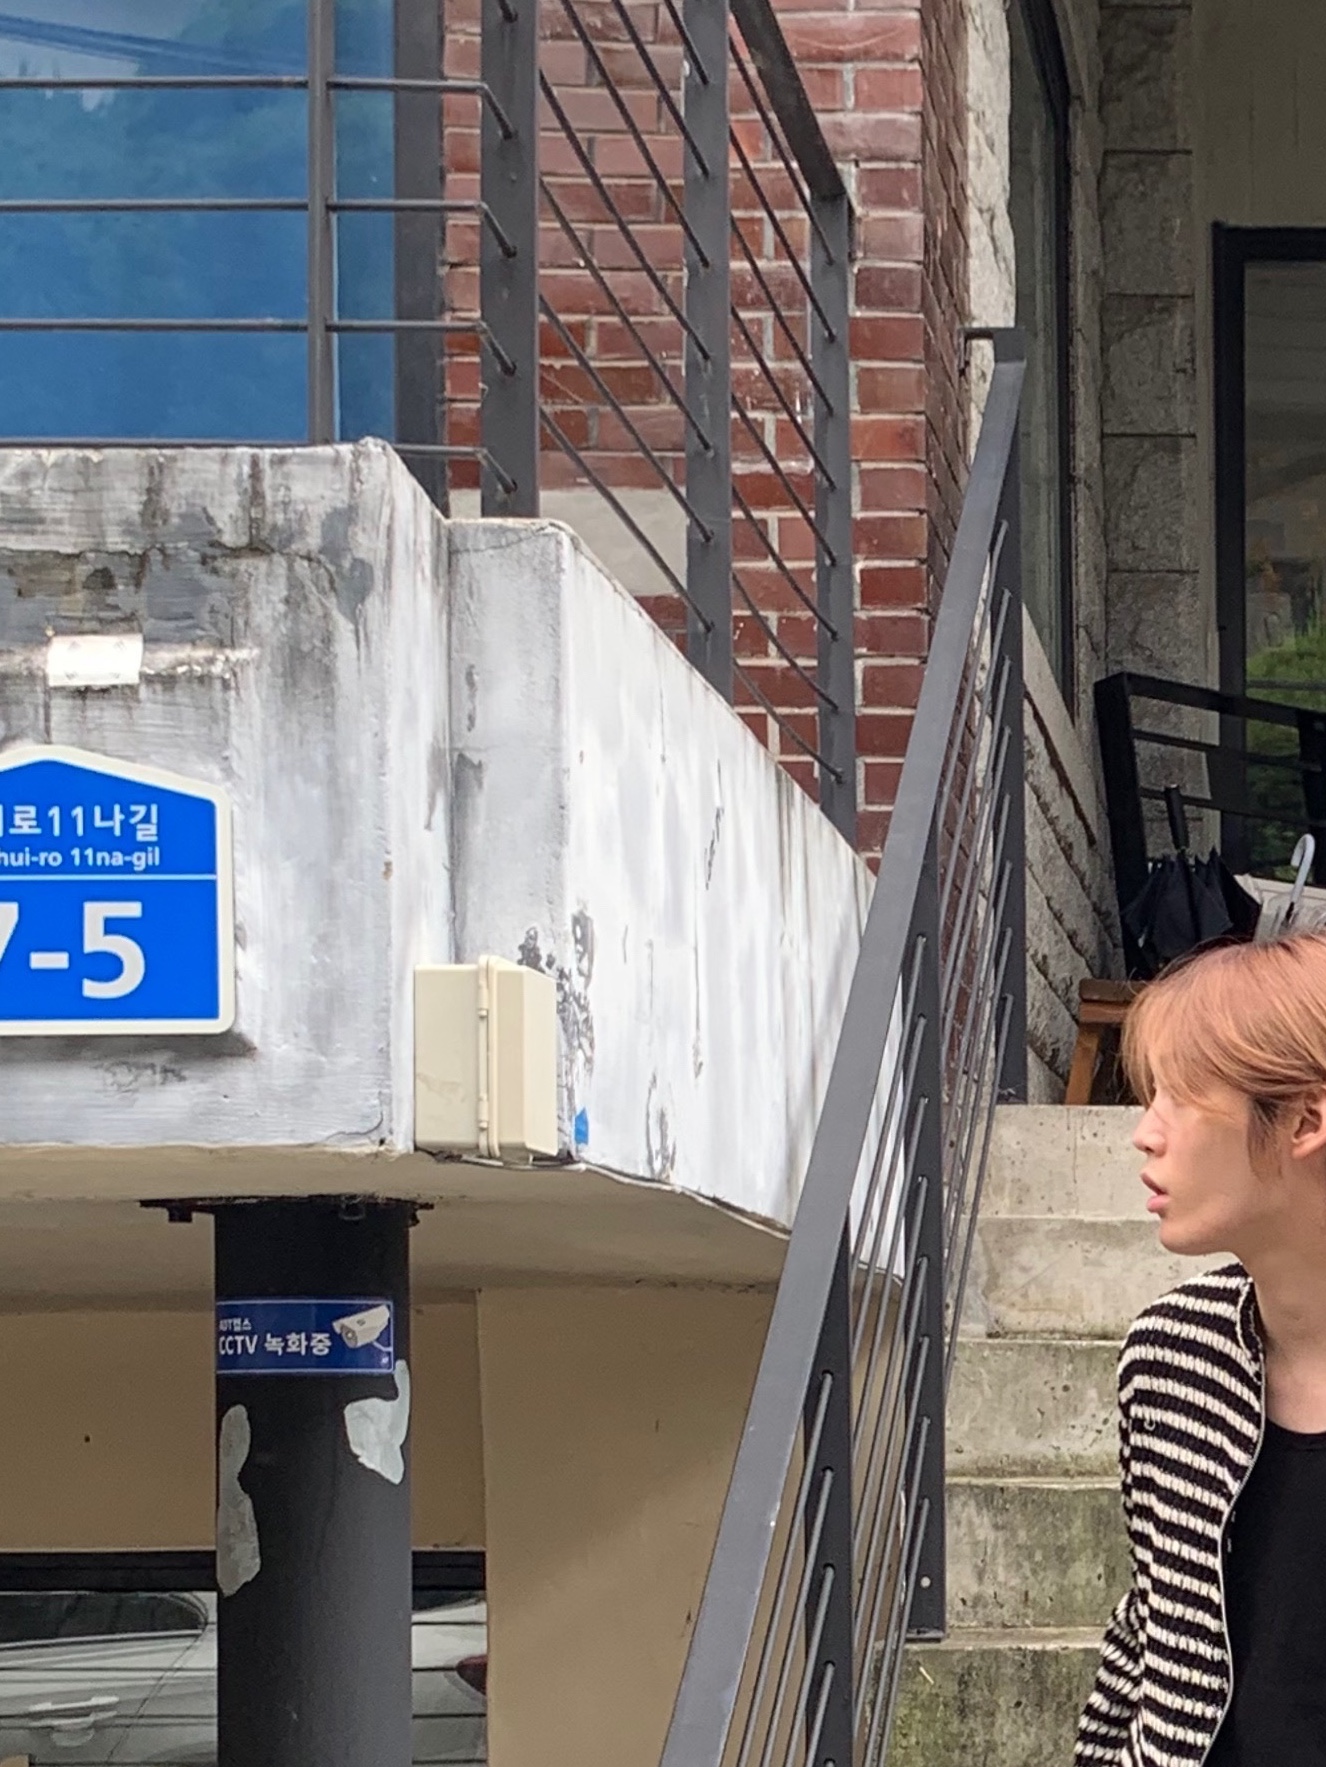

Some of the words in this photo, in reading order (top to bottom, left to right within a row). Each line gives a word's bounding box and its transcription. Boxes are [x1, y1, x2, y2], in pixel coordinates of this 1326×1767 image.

[0, 804, 159, 842] 로11나길
[71, 847, 160, 871] 11na-gil
[219, 1335, 258, 1355] CCTV
[264, 1332, 332, 1356] 녹화중
